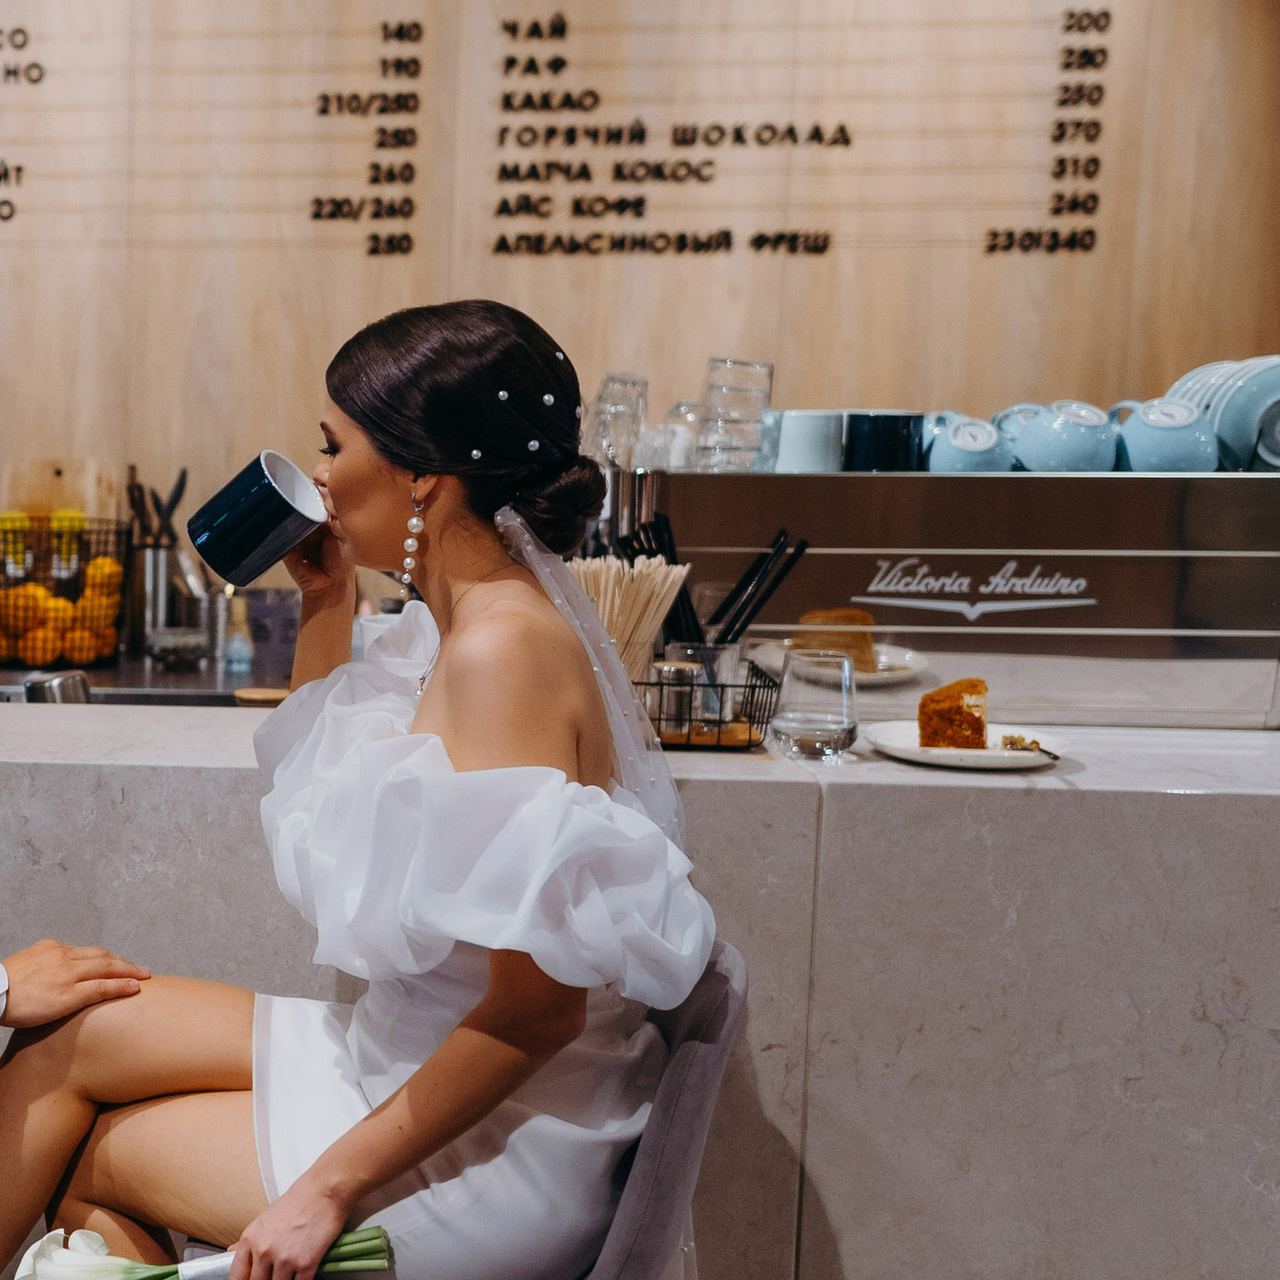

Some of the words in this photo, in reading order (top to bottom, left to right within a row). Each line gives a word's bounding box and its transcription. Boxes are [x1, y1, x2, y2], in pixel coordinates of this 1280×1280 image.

[379, 21, 423, 45] 140
[501, 12, 569, 41] ЧАЙ
[502, 54, 569, 77] РАФ
[500, 90, 601, 113] КАКАО
[497, 118, 648, 148] ГОРЯЧИЙ
[671, 122, 853, 148] ШОКОЛАД
[367, 162, 416, 186] 260
[497, 161, 593, 184] МАТЧА
[611, 159, 715, 184] КОКОС
[495, 193, 553, 219] АЙС
[571, 195, 648, 219] КОФЕ
[492, 229, 734, 256] АПЕЛЬСИНОВЫЙ
[748, 231, 832, 256] ФРЕШ
[867, 557, 971, 593] Victoria
[979, 560, 1088, 594] Arduino
